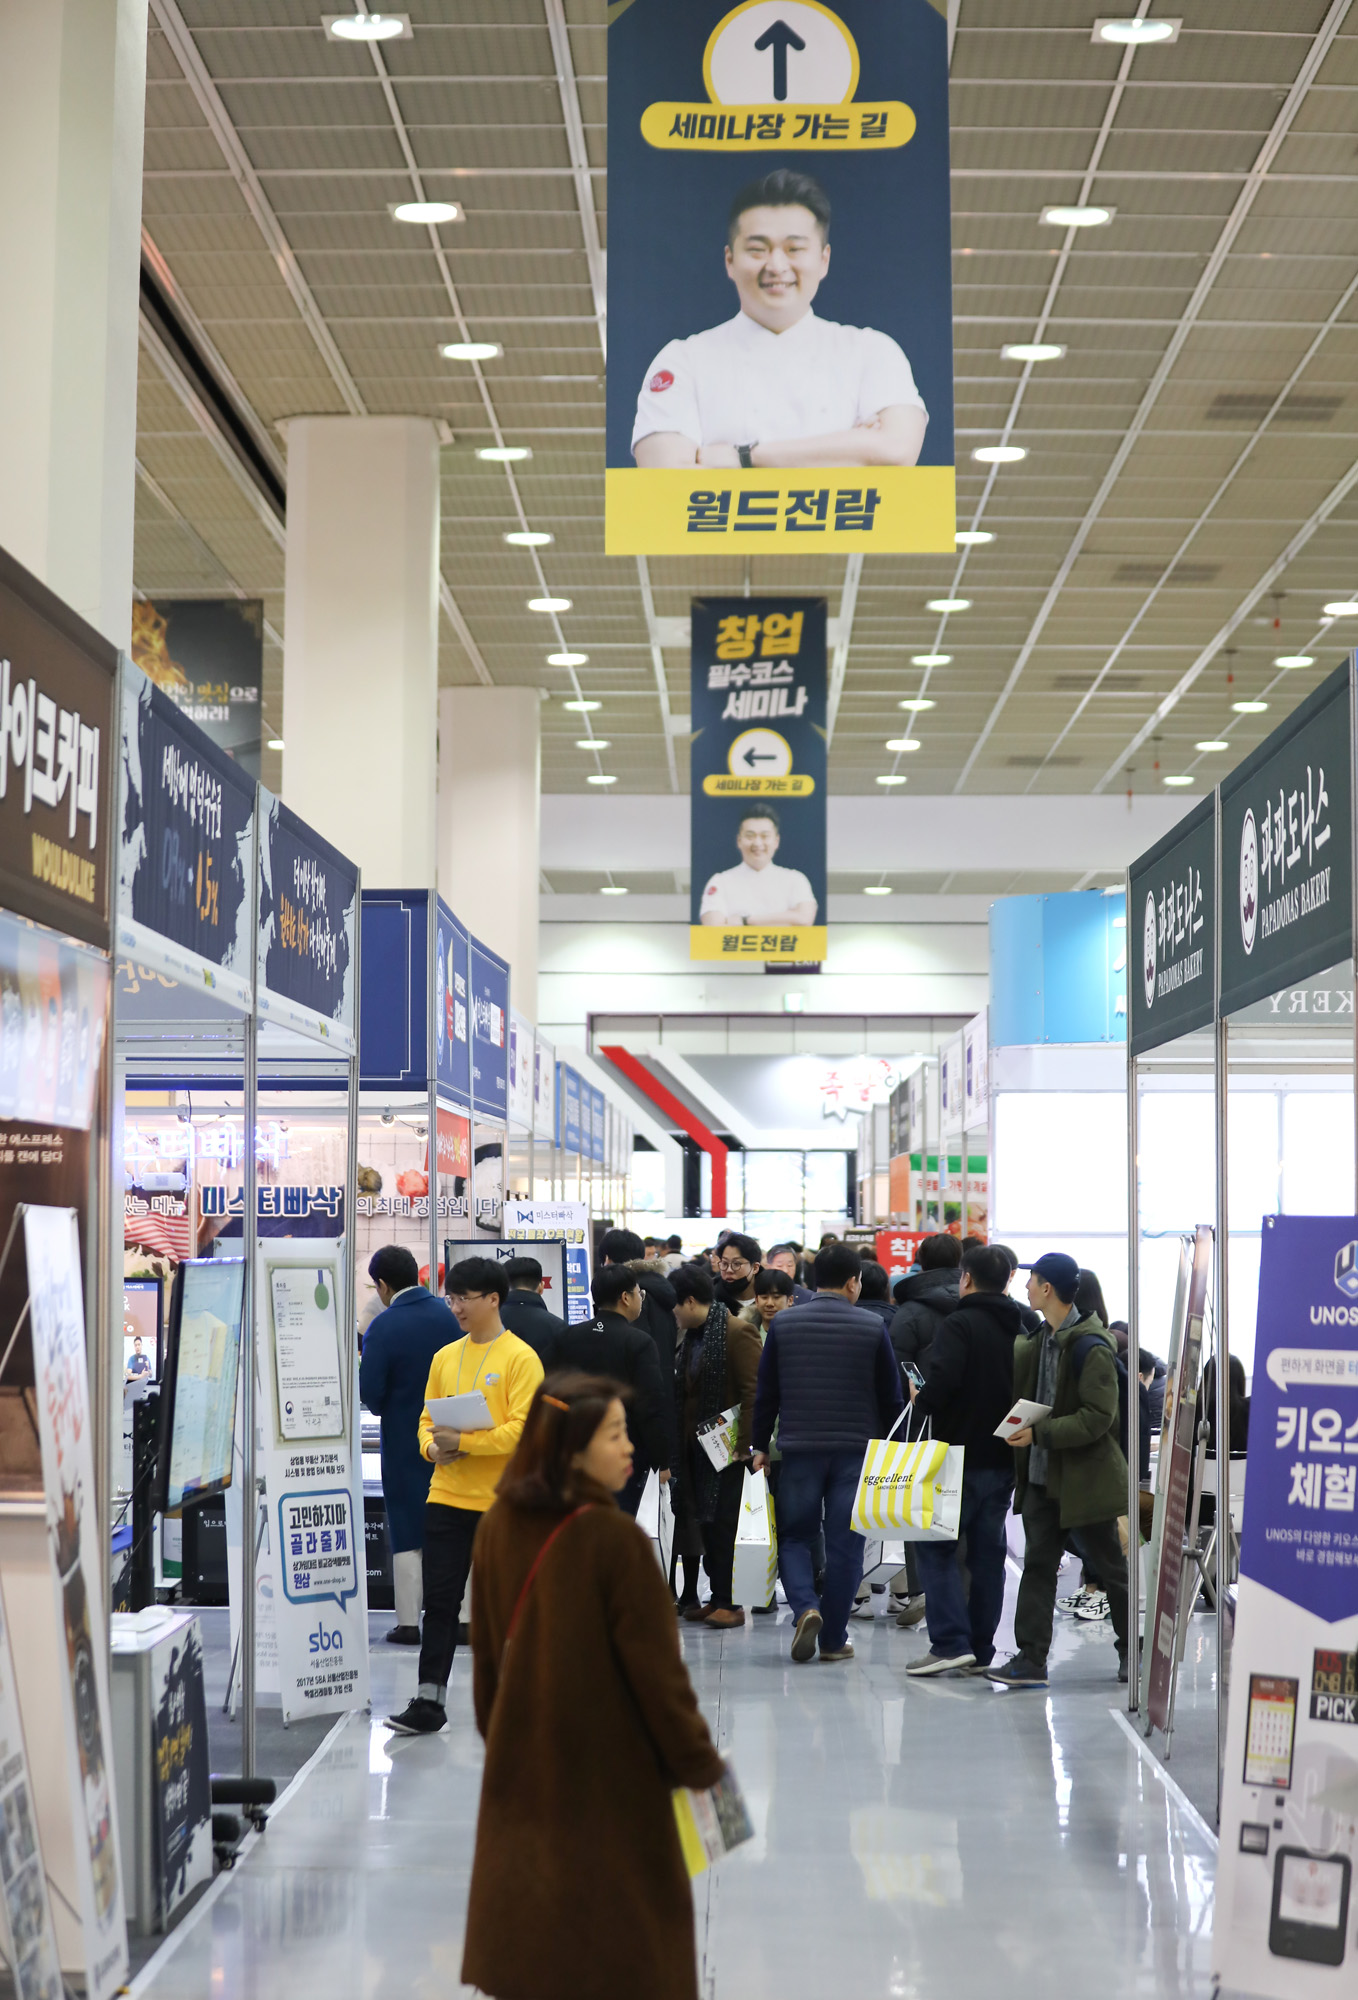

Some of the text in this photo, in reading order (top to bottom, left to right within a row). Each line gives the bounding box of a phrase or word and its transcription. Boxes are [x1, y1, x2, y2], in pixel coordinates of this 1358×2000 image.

[669, 112, 888, 140] 세미나장 가는 길
[687, 488, 881, 532] 월드전람
[717, 611, 804, 659] 창업
[708, 660, 794, 688] 필수코스
[722, 686, 808, 719] 세미나
[715, 779, 761, 791] 세미나장
[764, 780, 788, 791] 가는
[1261, 765, 1331, 893] 파파도나스
[1158, 865, 1203, 962] 파파도나스
[1261, 865, 1331, 939] PAPADONAS BAKERY
[722, 934, 798, 952] 월드전람
[152, 1195, 186, 1216] 메뉴
[202, 1185, 342, 1216] 미스터빠삭
[377, 1196, 410, 1216] 최대
[536, 1210, 573, 1221] 미스터빠삭
[1310, 1305, 1358, 1326] UNOS
[1281, 1357, 1312, 1373] 편하게
[1315, 1359, 1345, 1375] 화면을
[864, 1473, 913, 1486] eggcellent
[1288, 1462, 1357, 1512] 체험
[289, 1503, 346, 1529] 고민하지마
[294, 1572, 311, 1589] 원샵
[309, 1621, 343, 1653] sba
[296, 1676, 314, 1688] 2017년
[315, 1674, 326, 1685] SBA
[1316, 1695, 1356, 1722] PICK
